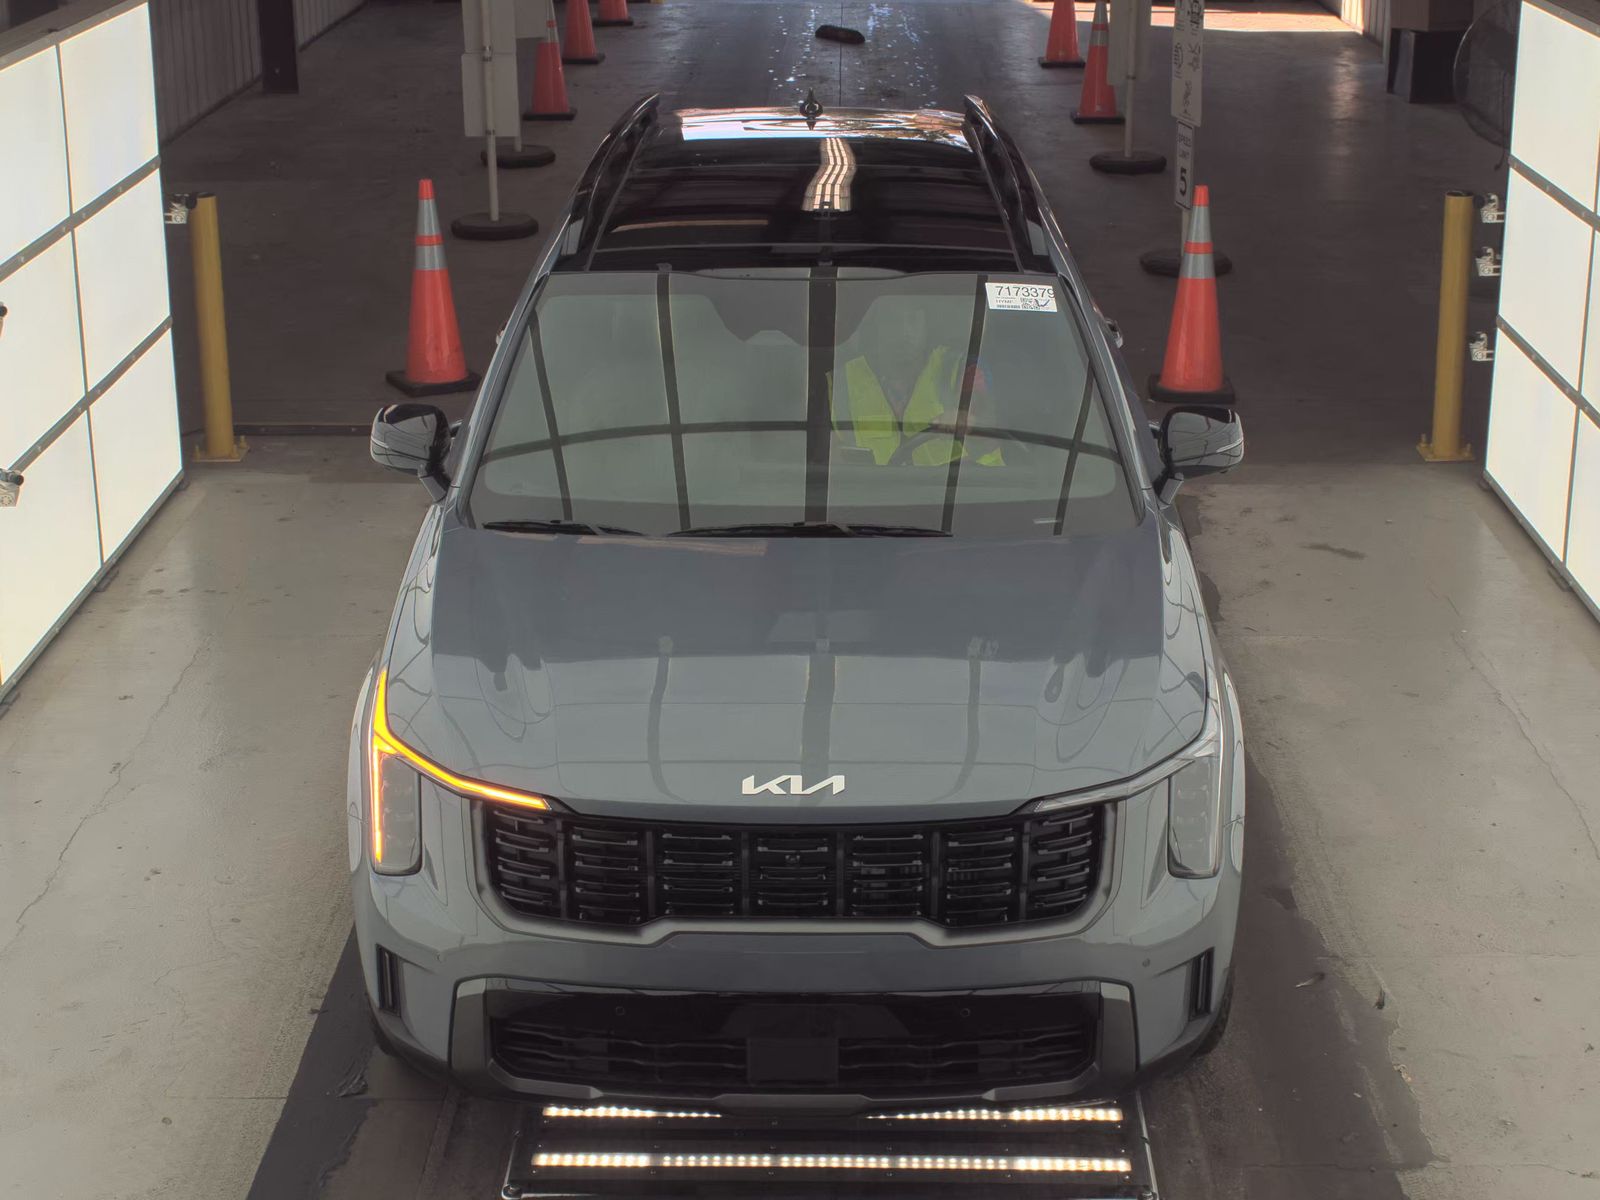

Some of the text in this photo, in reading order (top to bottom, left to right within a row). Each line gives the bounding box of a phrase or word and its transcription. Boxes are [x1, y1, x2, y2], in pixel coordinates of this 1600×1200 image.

[1180, 166, 1187, 197] 5
[995, 286, 1056, 298] 7173379
[742, 775, 845, 795] KIA
